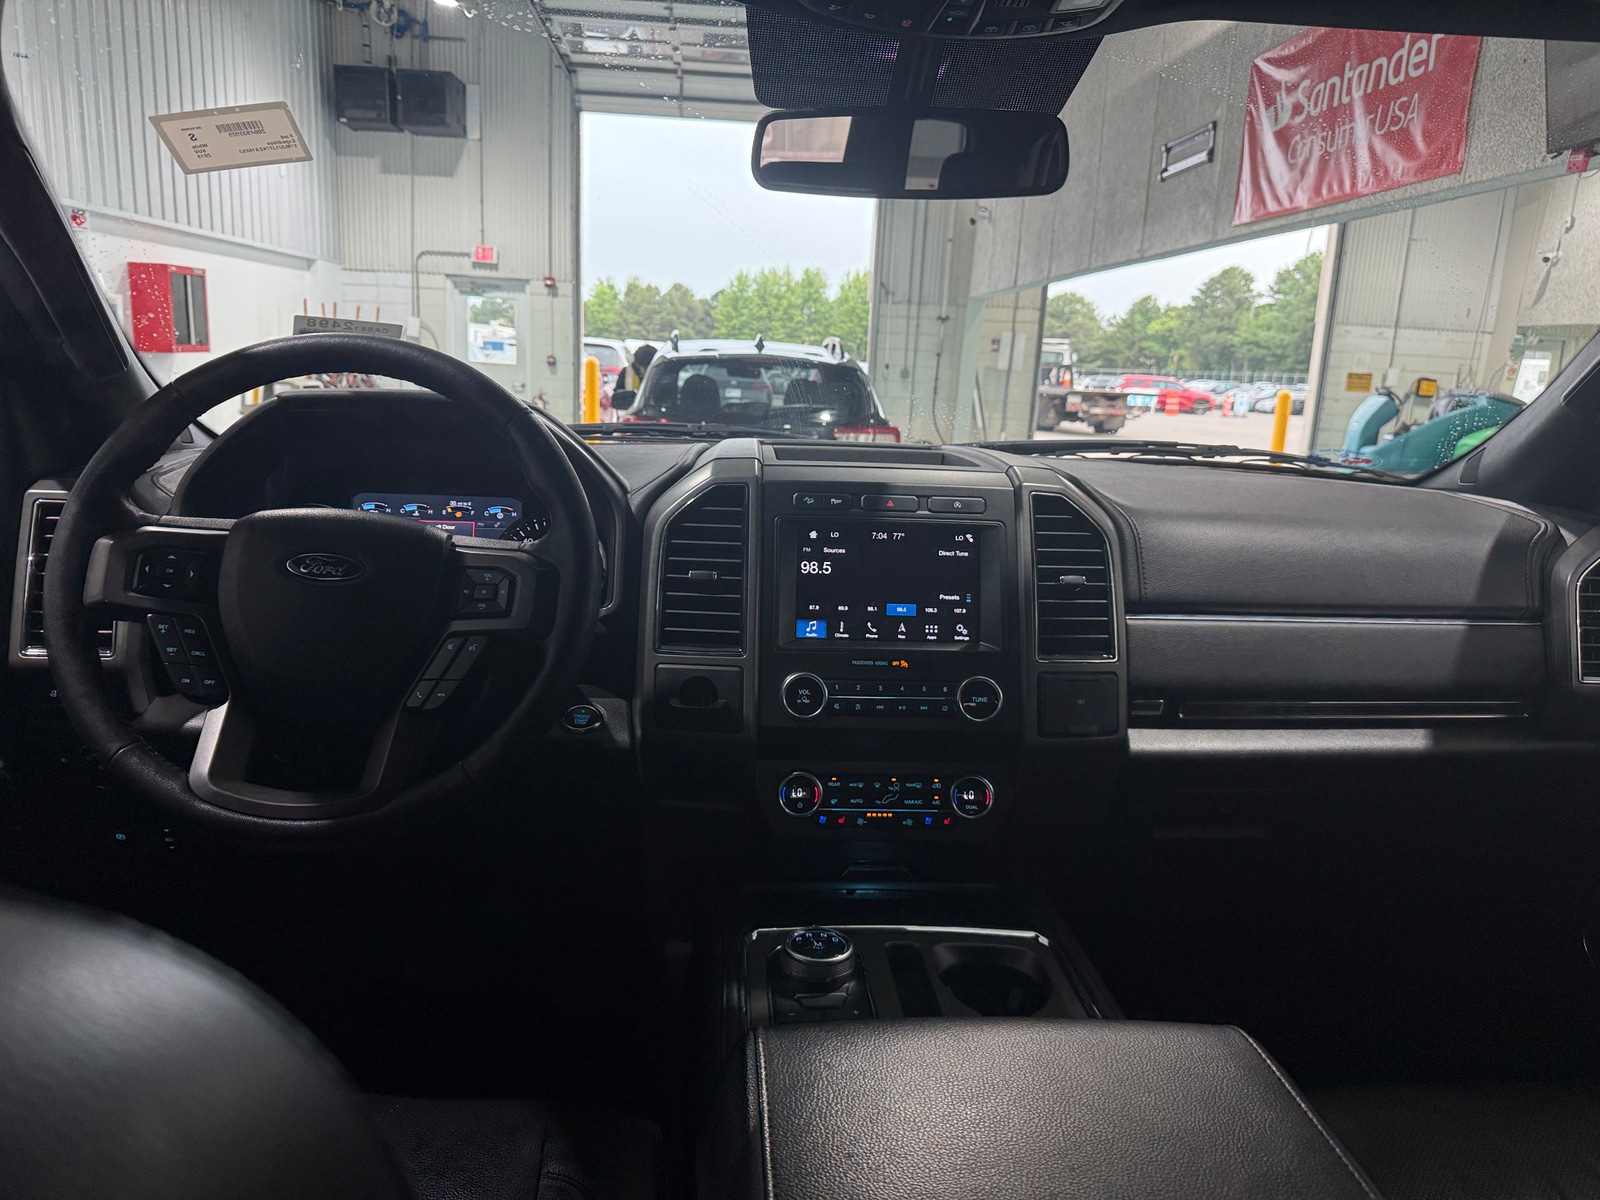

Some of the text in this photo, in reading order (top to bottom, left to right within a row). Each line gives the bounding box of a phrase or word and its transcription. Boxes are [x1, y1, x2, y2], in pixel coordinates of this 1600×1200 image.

[1294, 33, 1444, 123] Santander
[1288, 92, 1419, 164] Consumr USA
[872, 532, 888, 540] 7:04
[300, 556, 349, 576] Ford
[800, 561, 832, 575] 98.5
[963, 790, 975, 799] LO
